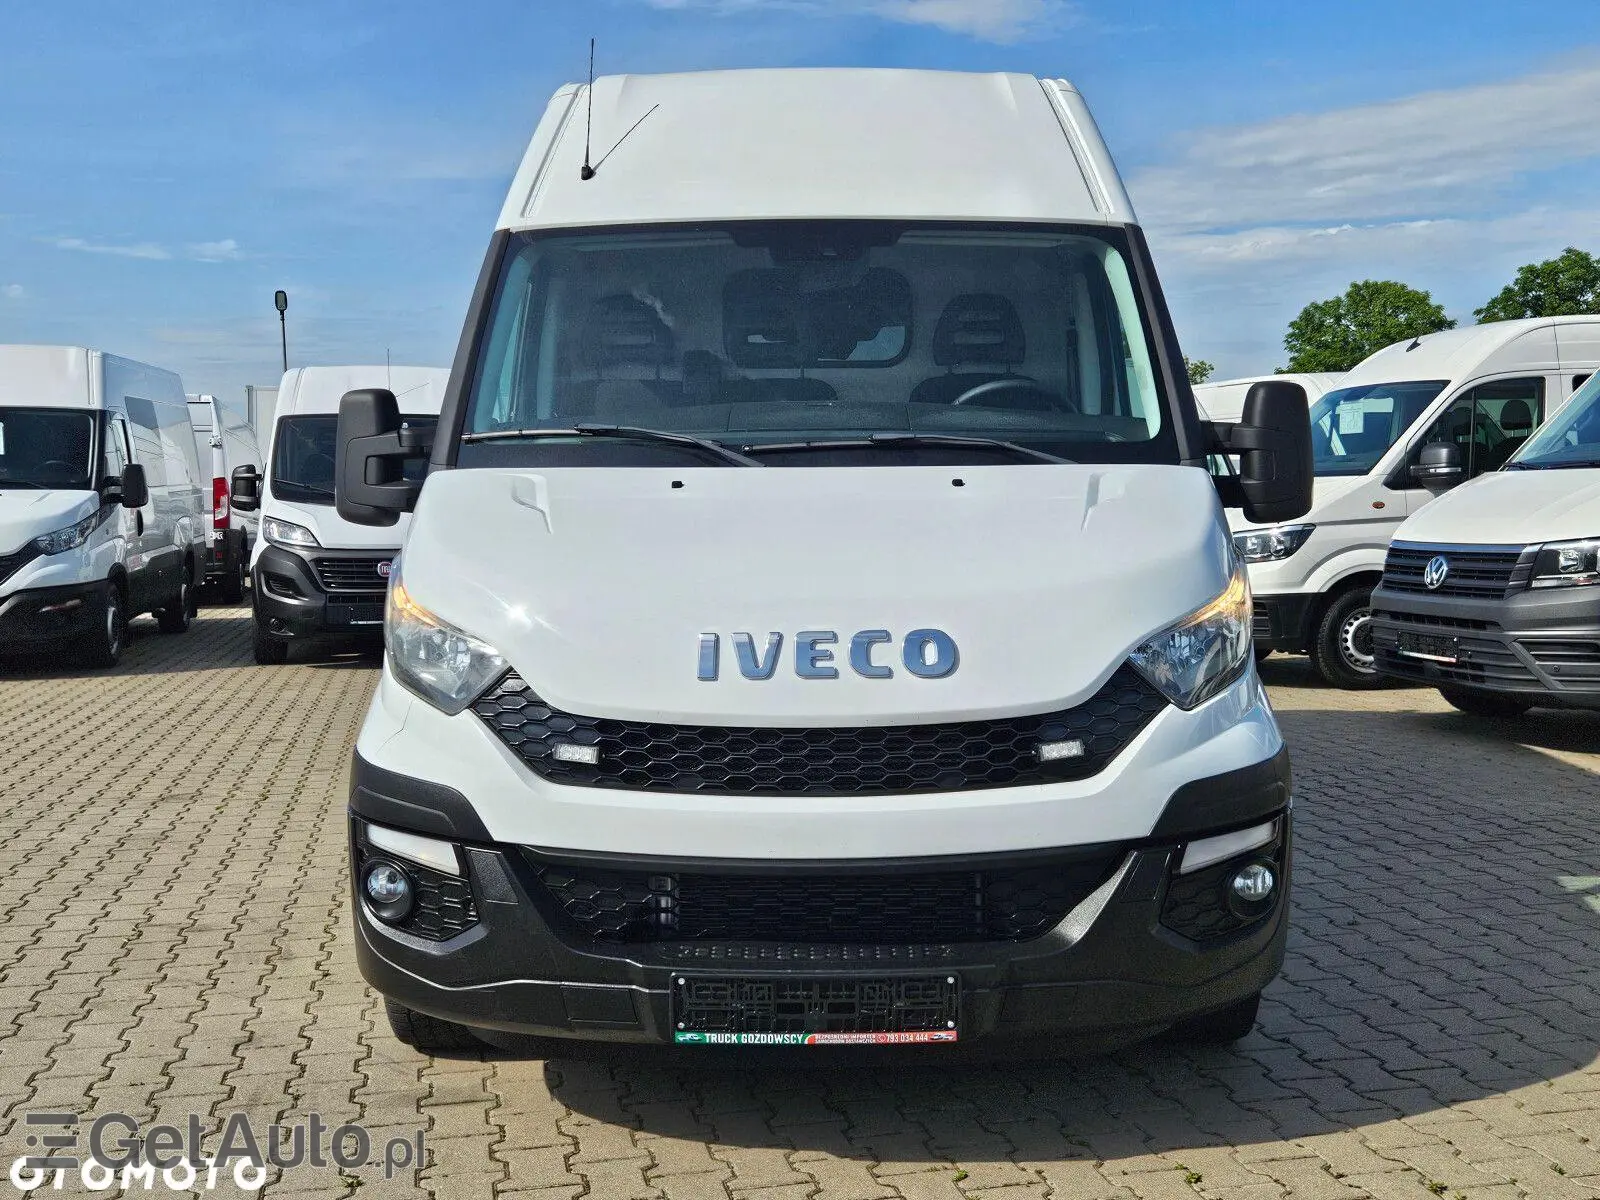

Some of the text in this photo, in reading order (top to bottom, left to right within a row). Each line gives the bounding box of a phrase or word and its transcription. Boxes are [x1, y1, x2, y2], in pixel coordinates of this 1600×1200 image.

[697, 628, 959, 681] IVECO
[705, 1033, 803, 1044] TRUCK GOZDOWSCY
[886, 1033, 928, 1043] 793 034 444
